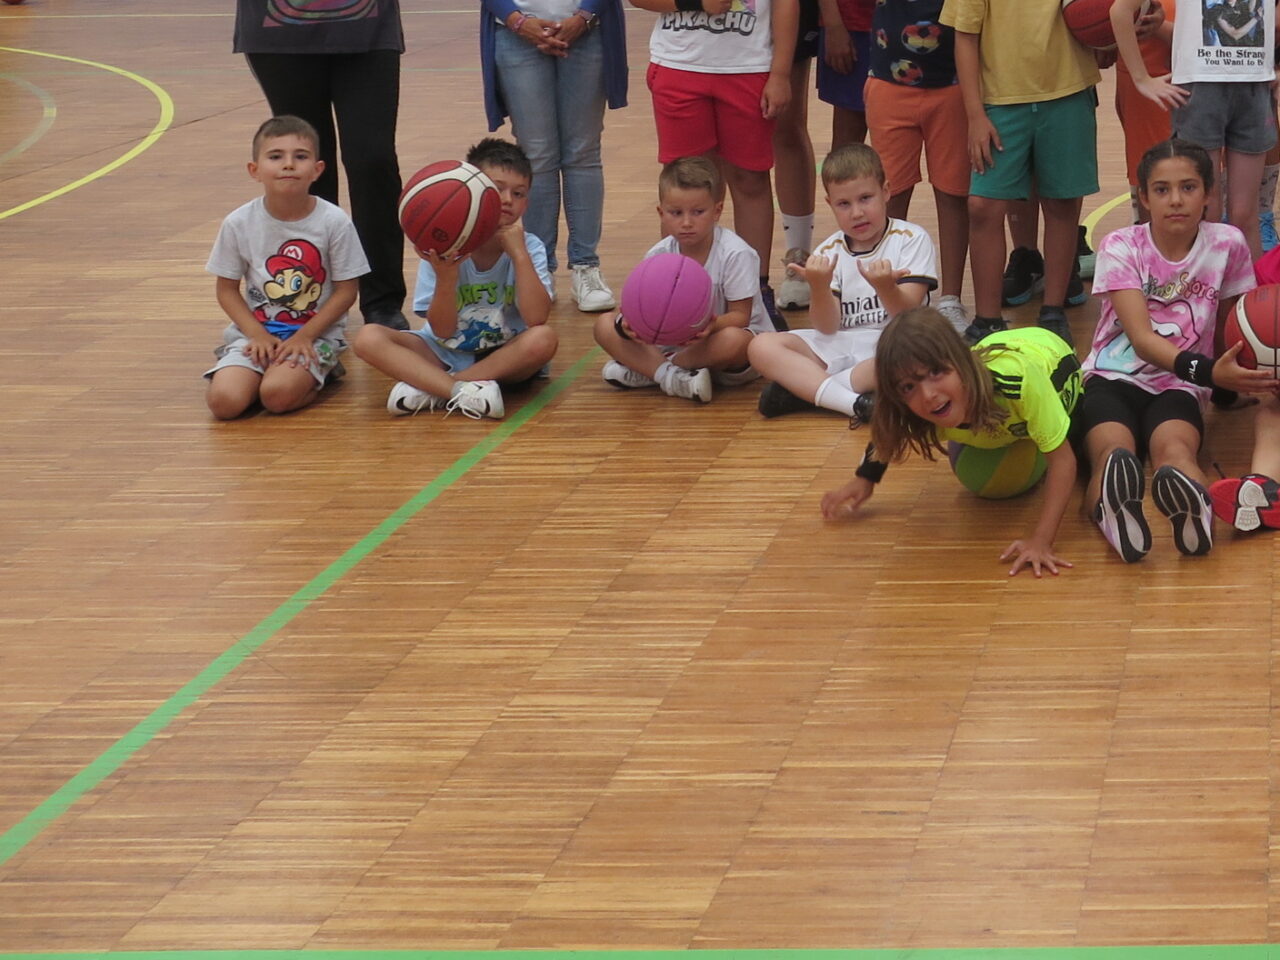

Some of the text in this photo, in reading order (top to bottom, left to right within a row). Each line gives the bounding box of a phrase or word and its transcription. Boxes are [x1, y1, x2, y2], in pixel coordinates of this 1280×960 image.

[662, 11, 756, 36] PIKACHU
[1198, 49, 1212, 57] Be
[1216, 49, 1231, 57] the
